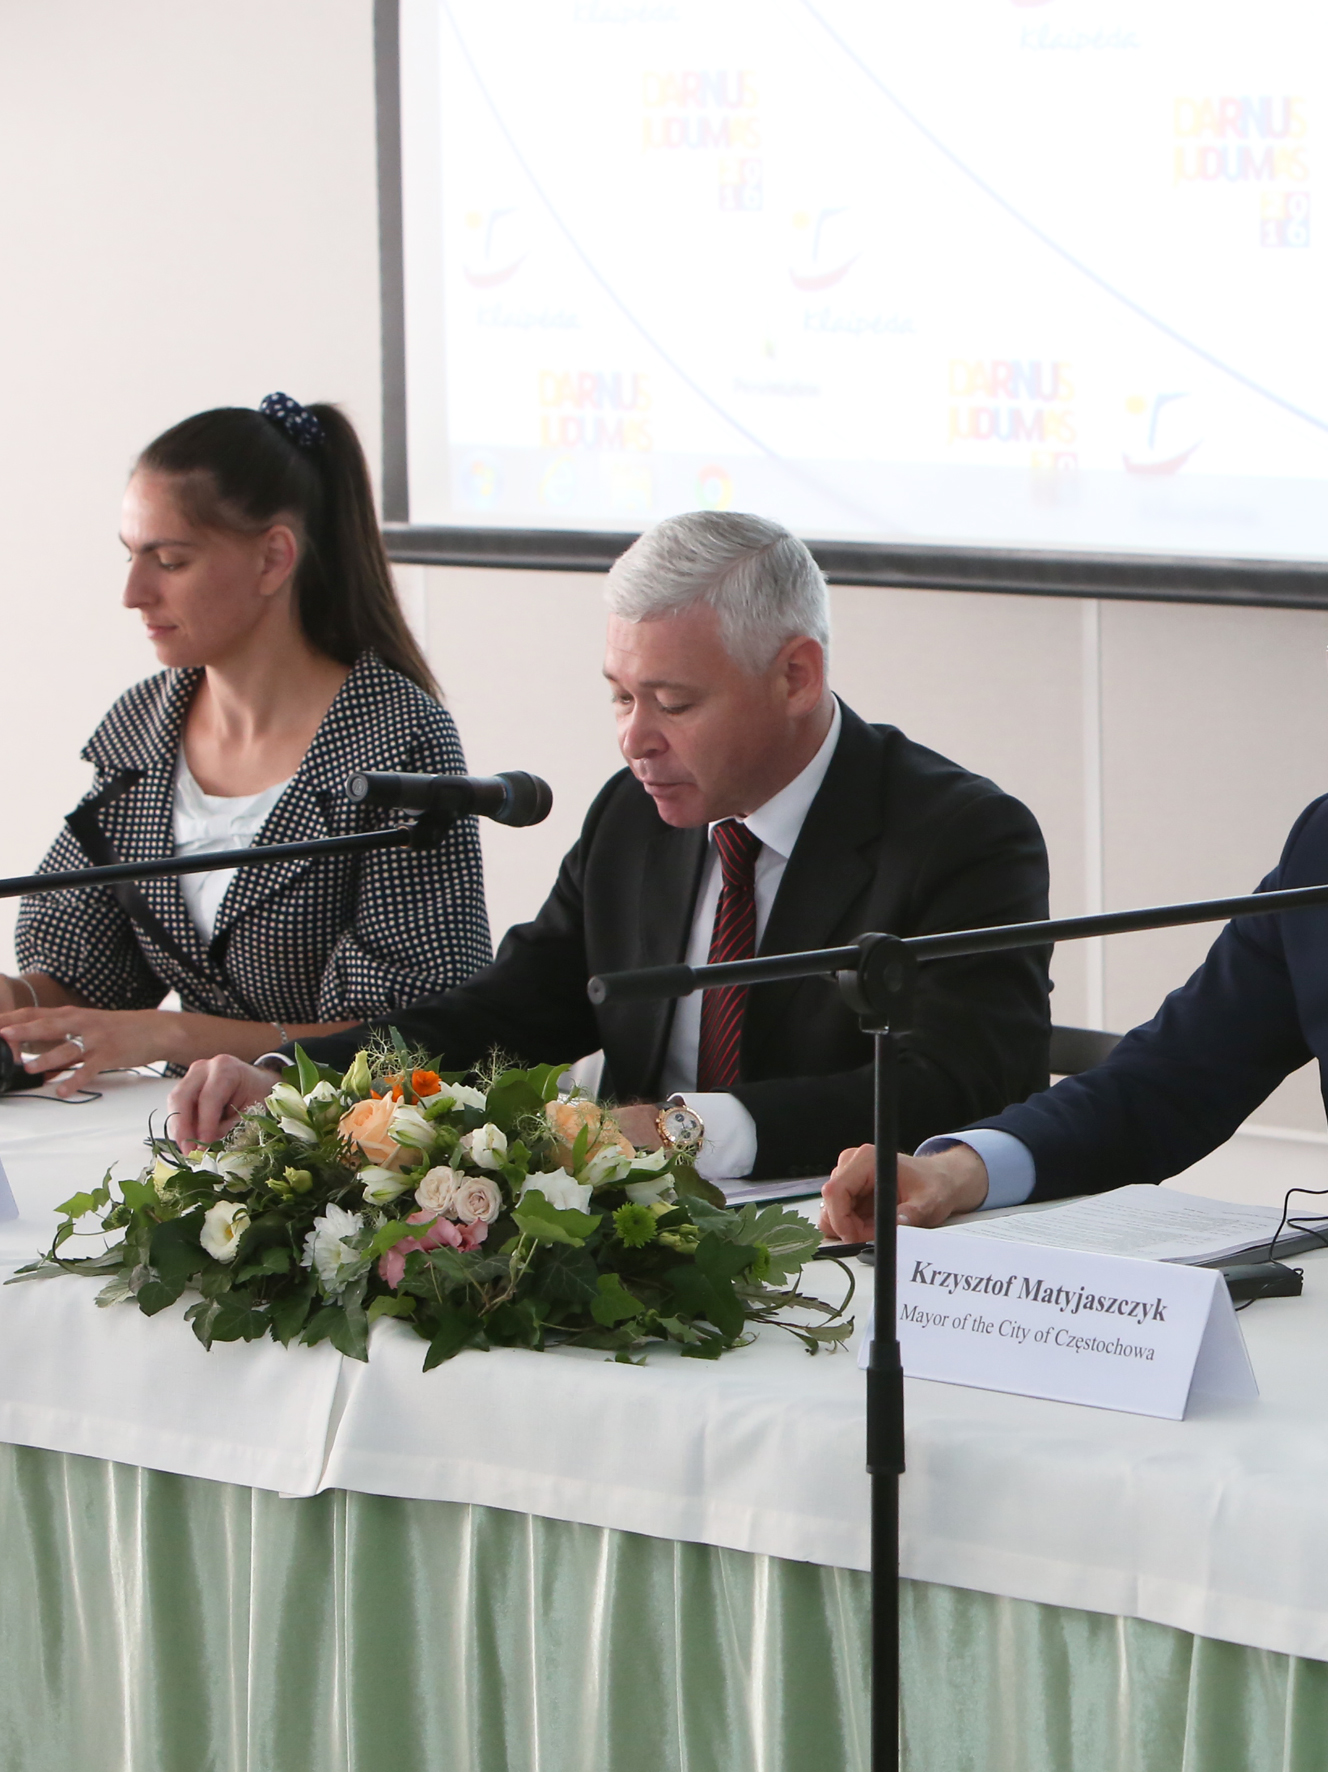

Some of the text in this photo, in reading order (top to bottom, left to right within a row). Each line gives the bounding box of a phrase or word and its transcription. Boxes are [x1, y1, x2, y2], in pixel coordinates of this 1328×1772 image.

[641, 69, 759, 109] DARNUS
[1172, 95, 1309, 139] DARNUS
[1172, 144, 1311, 187] JUDUMAS
[538, 369, 652, 412] DARNUS
[948, 359, 1077, 402] DARNUS
[946, 406, 1077, 446] JUDUMAS
[910, 1260, 1168, 1325] Krzysztof Matyjaszczyk
[900, 1303, 1155, 1362] Mayor of the City of Częstochowa
